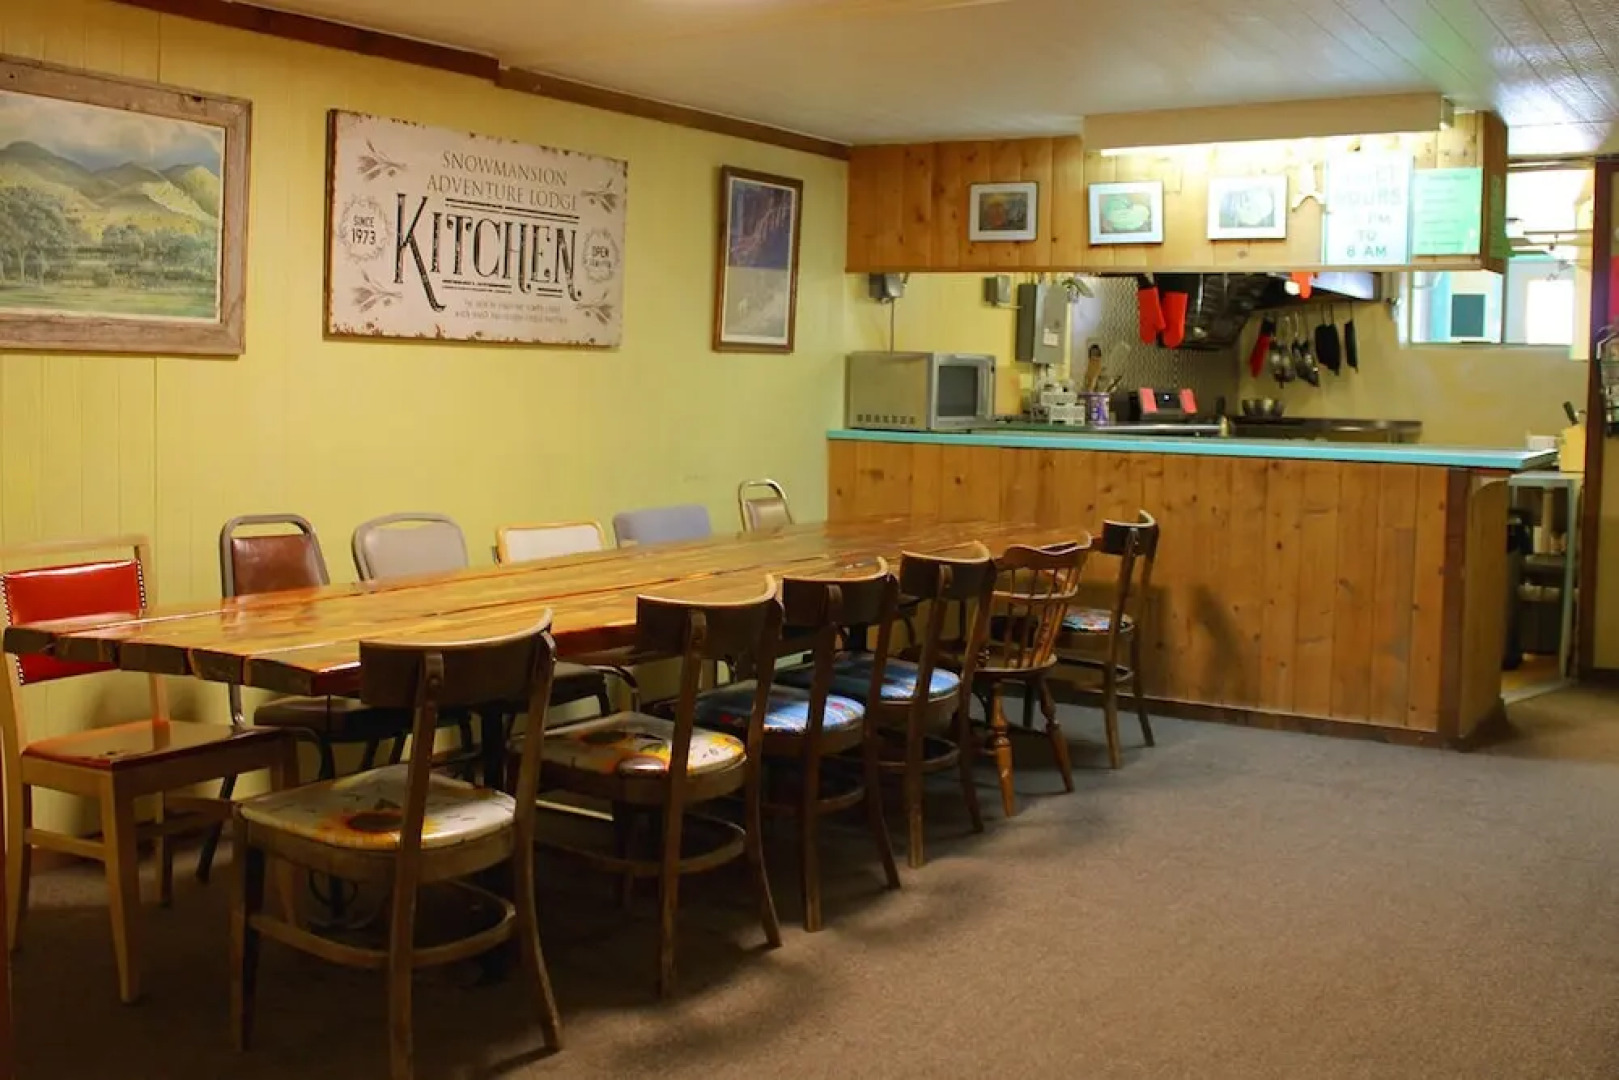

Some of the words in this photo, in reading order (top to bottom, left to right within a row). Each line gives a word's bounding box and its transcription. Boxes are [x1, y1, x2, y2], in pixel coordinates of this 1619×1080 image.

[442, 150, 568, 187] SNOWMANSION
[426, 174, 525, 203] ADVENTURE
[352, 215, 374, 228] SINCE
[352, 227, 376, 245] 1973
[1357, 229, 1377, 242] TO
[394, 192, 582, 313] KITCHEN
[1364, 245, 1387, 258] AM
